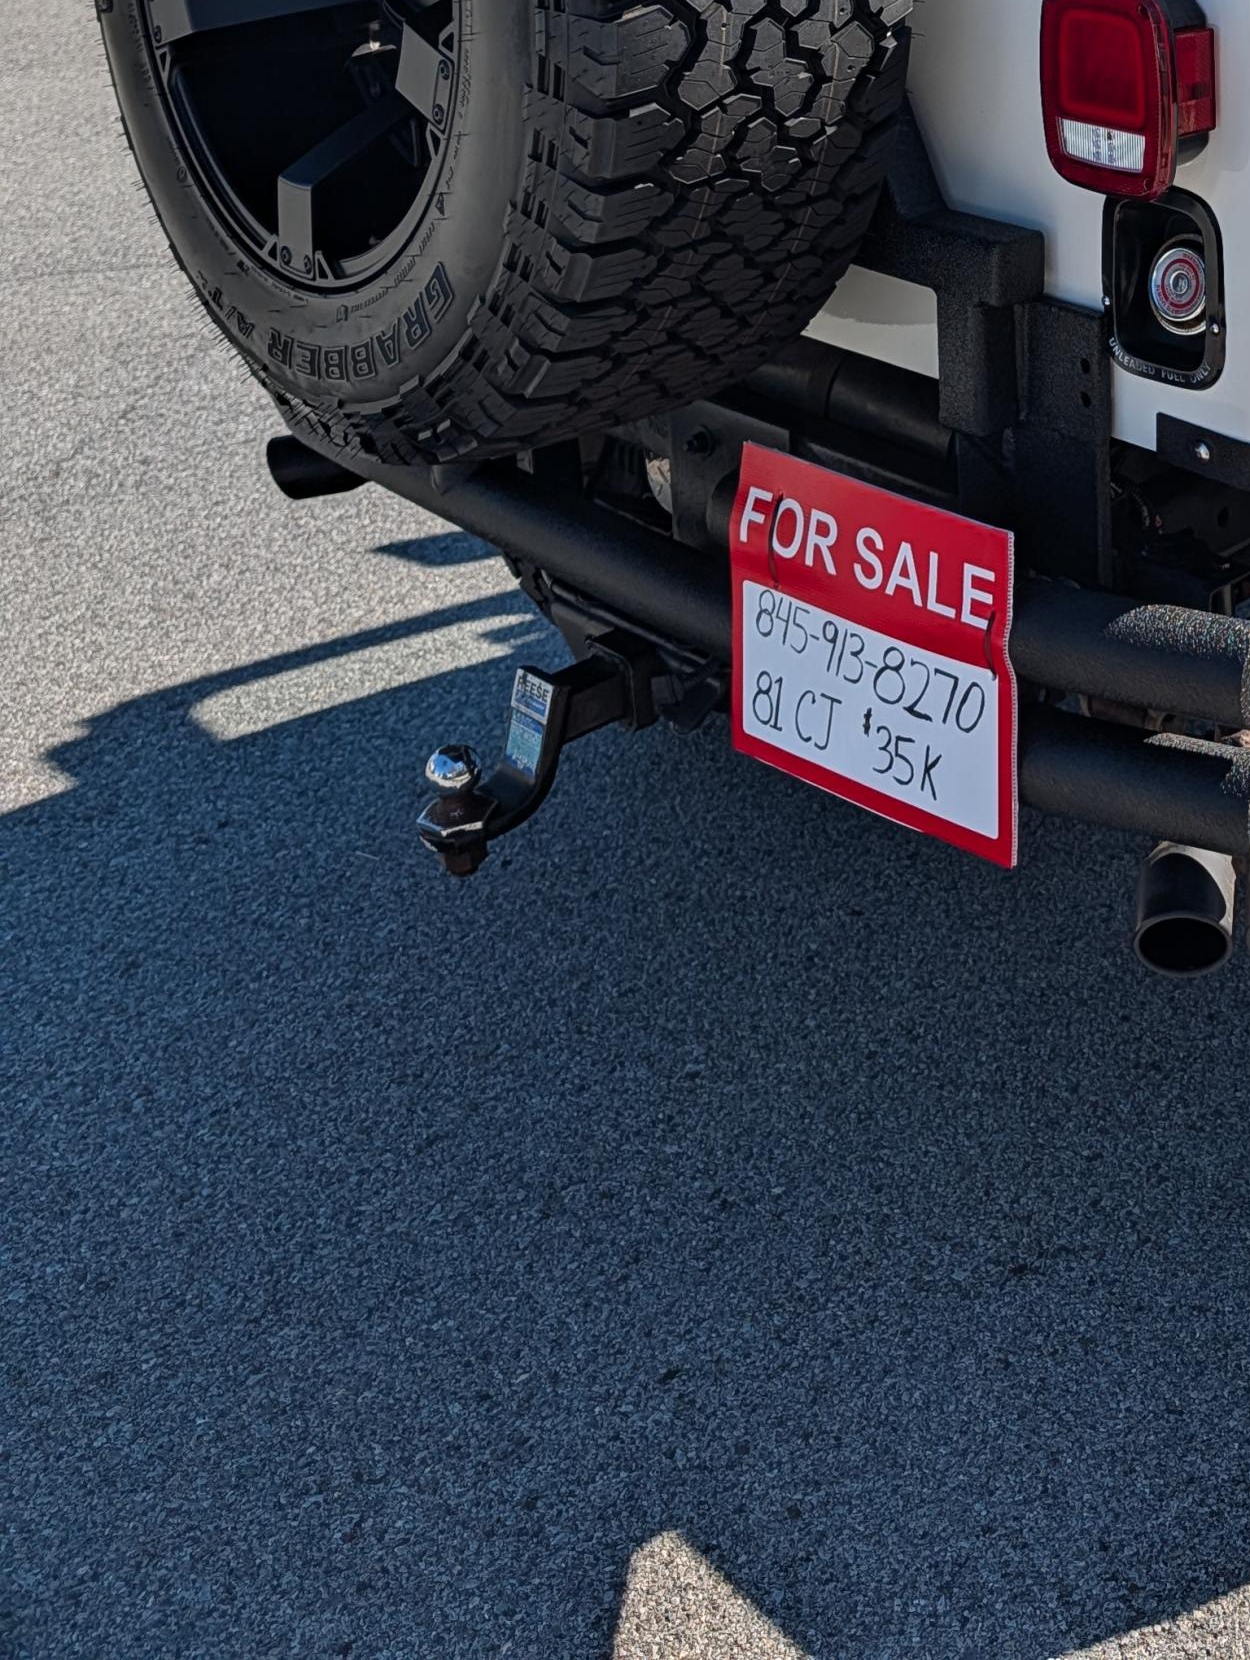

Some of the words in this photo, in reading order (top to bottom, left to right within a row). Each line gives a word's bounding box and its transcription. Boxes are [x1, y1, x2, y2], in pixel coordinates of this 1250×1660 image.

[267, 261, 454, 381] GRABBER
[1108, 337, 1156, 375] UNLEADED
[1161, 369, 1186, 383] FUEL
[1191, 360, 1211, 384] ONLY
[739, 486, 838, 576] FOR
[853, 527, 996, 630] SALE
[752, 670, 784, 732] 81
[794, 689, 843, 751] CJ
[755, 589, 986, 734] 845-913-8270
